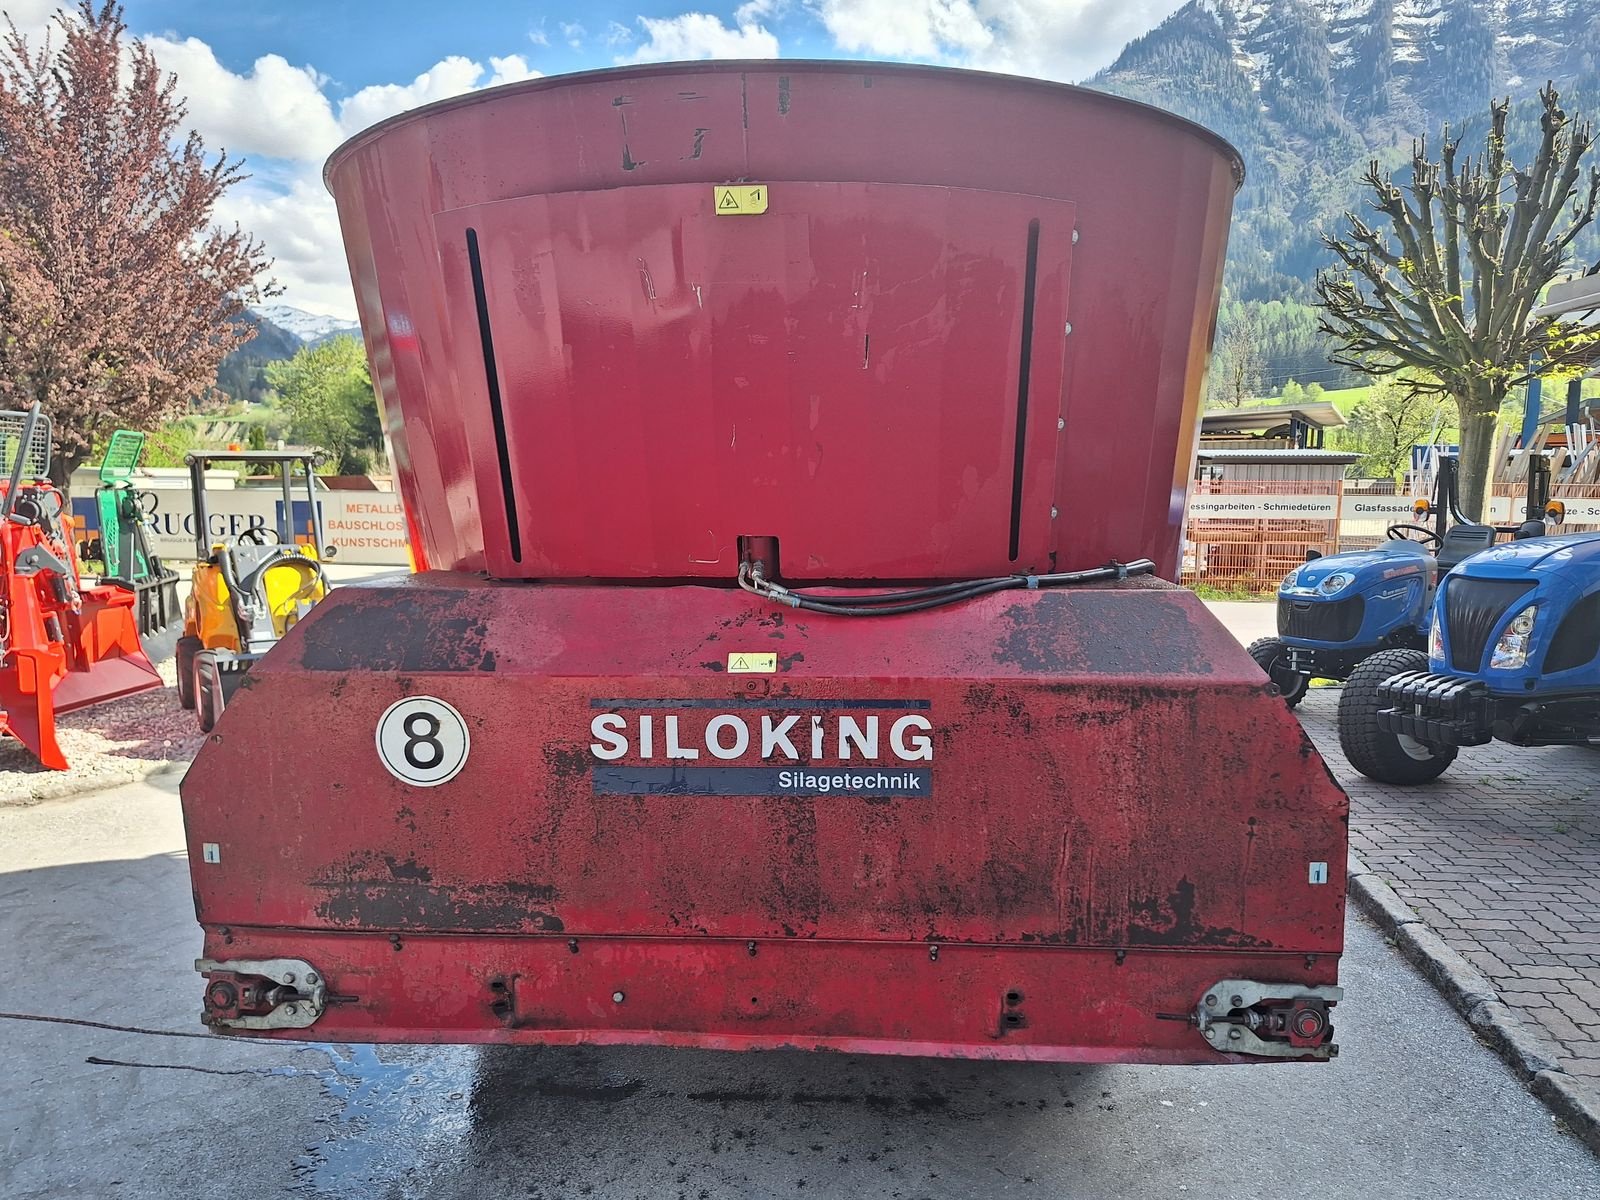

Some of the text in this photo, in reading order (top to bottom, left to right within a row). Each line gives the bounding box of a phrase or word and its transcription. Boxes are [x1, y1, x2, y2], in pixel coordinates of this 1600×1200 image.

[1263, 502, 1331, 511] Schmiedetüren
[142, 512, 268, 536] RUGGER
[403, 711, 444, 770] 8
[590, 713, 934, 761] SILOKING
[778, 771, 922, 793] Silagetechnik
